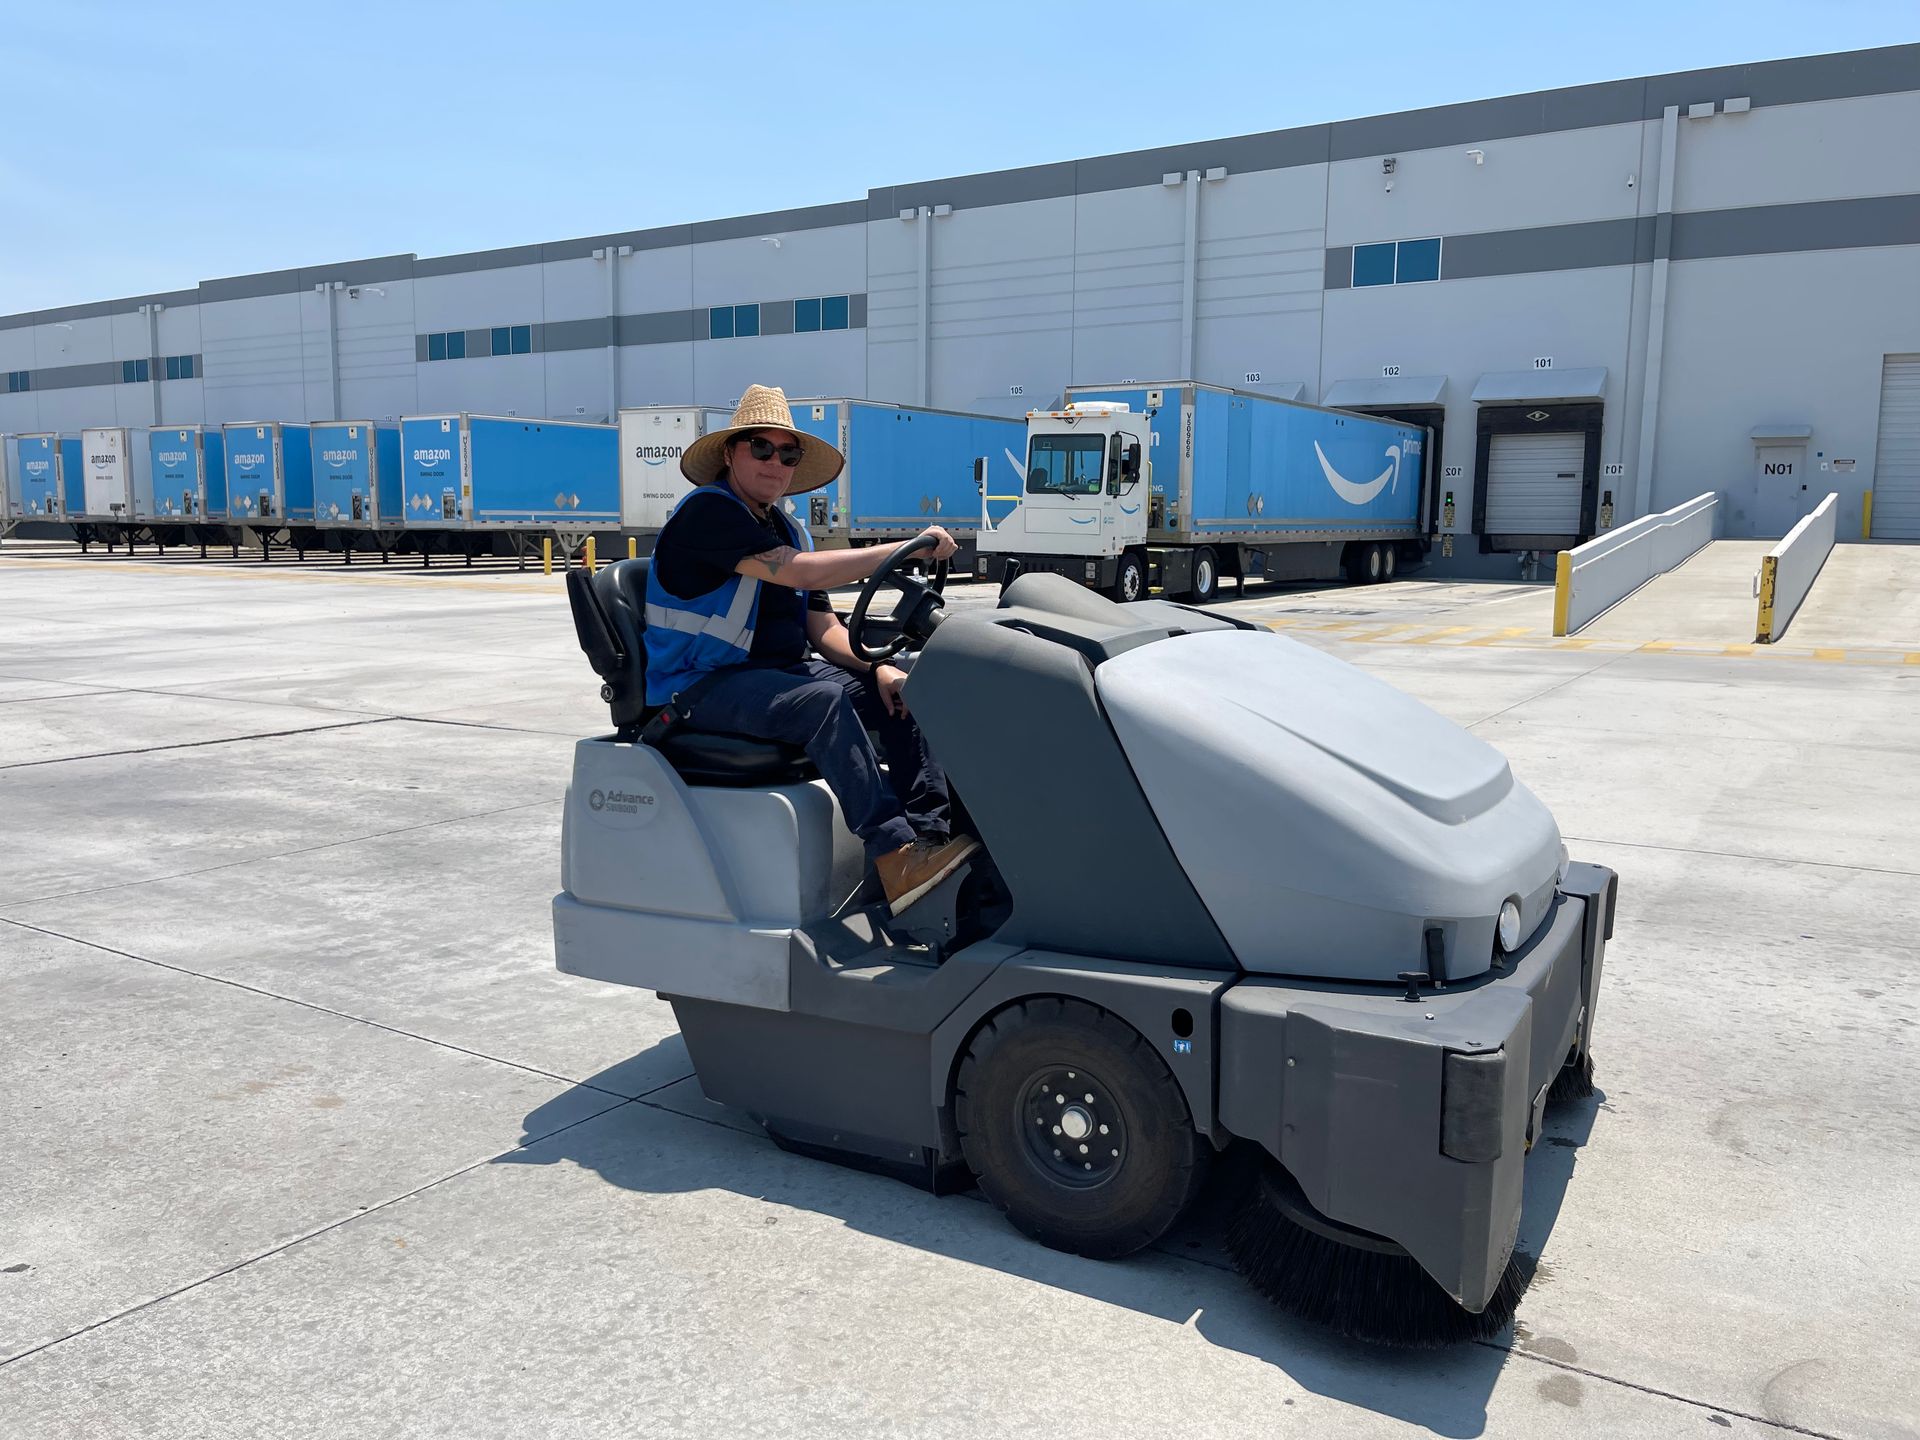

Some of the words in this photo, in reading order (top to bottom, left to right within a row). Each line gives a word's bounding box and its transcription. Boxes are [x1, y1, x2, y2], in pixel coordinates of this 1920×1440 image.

[1535, 358, 1551, 368] 101
[1384, 366, 1399, 376] 102
[1246, 373, 1260, 382] 103
[1010, 386, 1023, 395] 105
[636, 445, 682, 458] amazon
[1403, 435, 1422, 458] prime
[91, 454, 117, 464] amazon
[159, 451, 187, 461] amazon
[234, 454, 265, 464] amazon
[323, 450, 357, 461] amazon
[414, 449, 451, 460] amazon
[1765, 463, 1792, 475] N01
[607, 790, 654, 805] Advance
